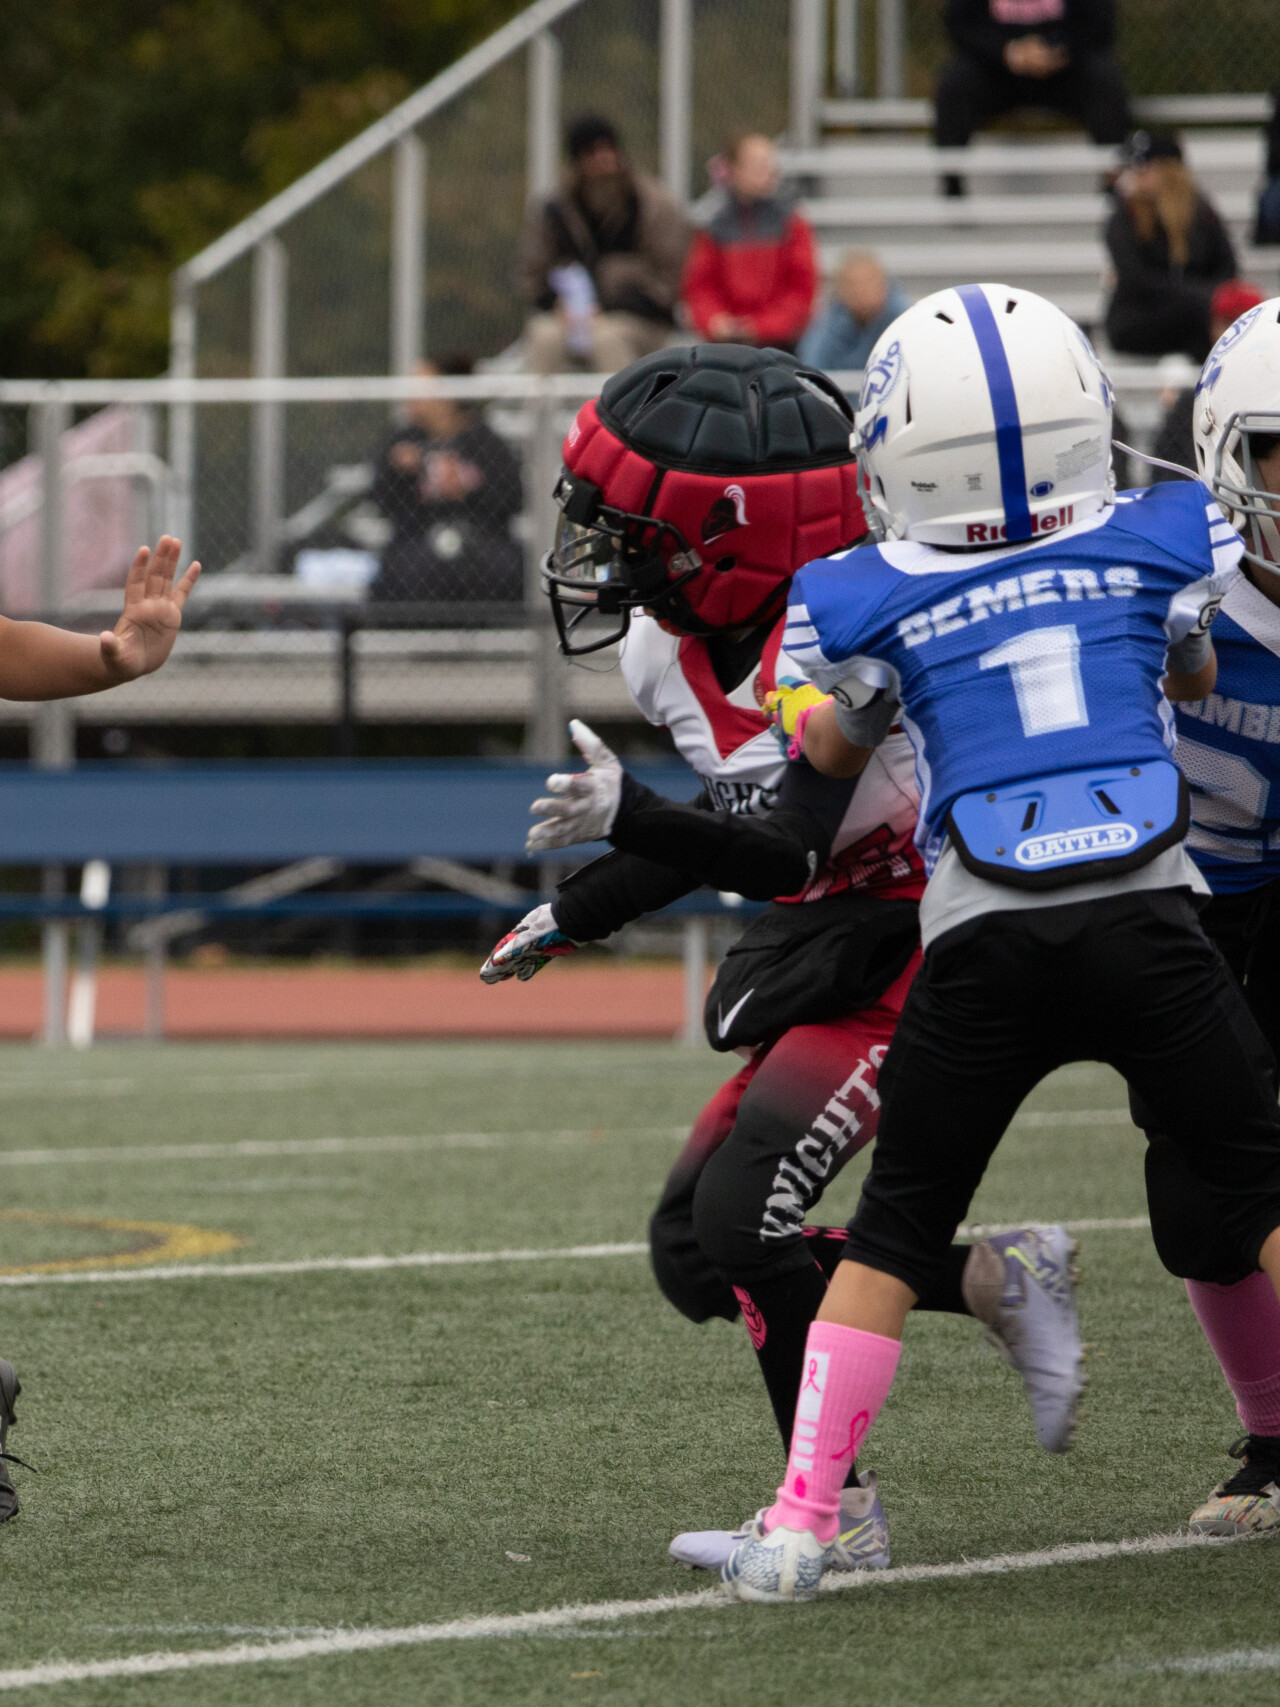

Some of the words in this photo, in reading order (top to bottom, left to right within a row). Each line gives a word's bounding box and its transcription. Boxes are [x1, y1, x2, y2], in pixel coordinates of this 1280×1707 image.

[966, 504, 1074, 543] Riell
[897, 566, 1144, 650] DEMERS
[978, 624, 1090, 738] 1
[1026, 828, 1126, 860] BATTLE
